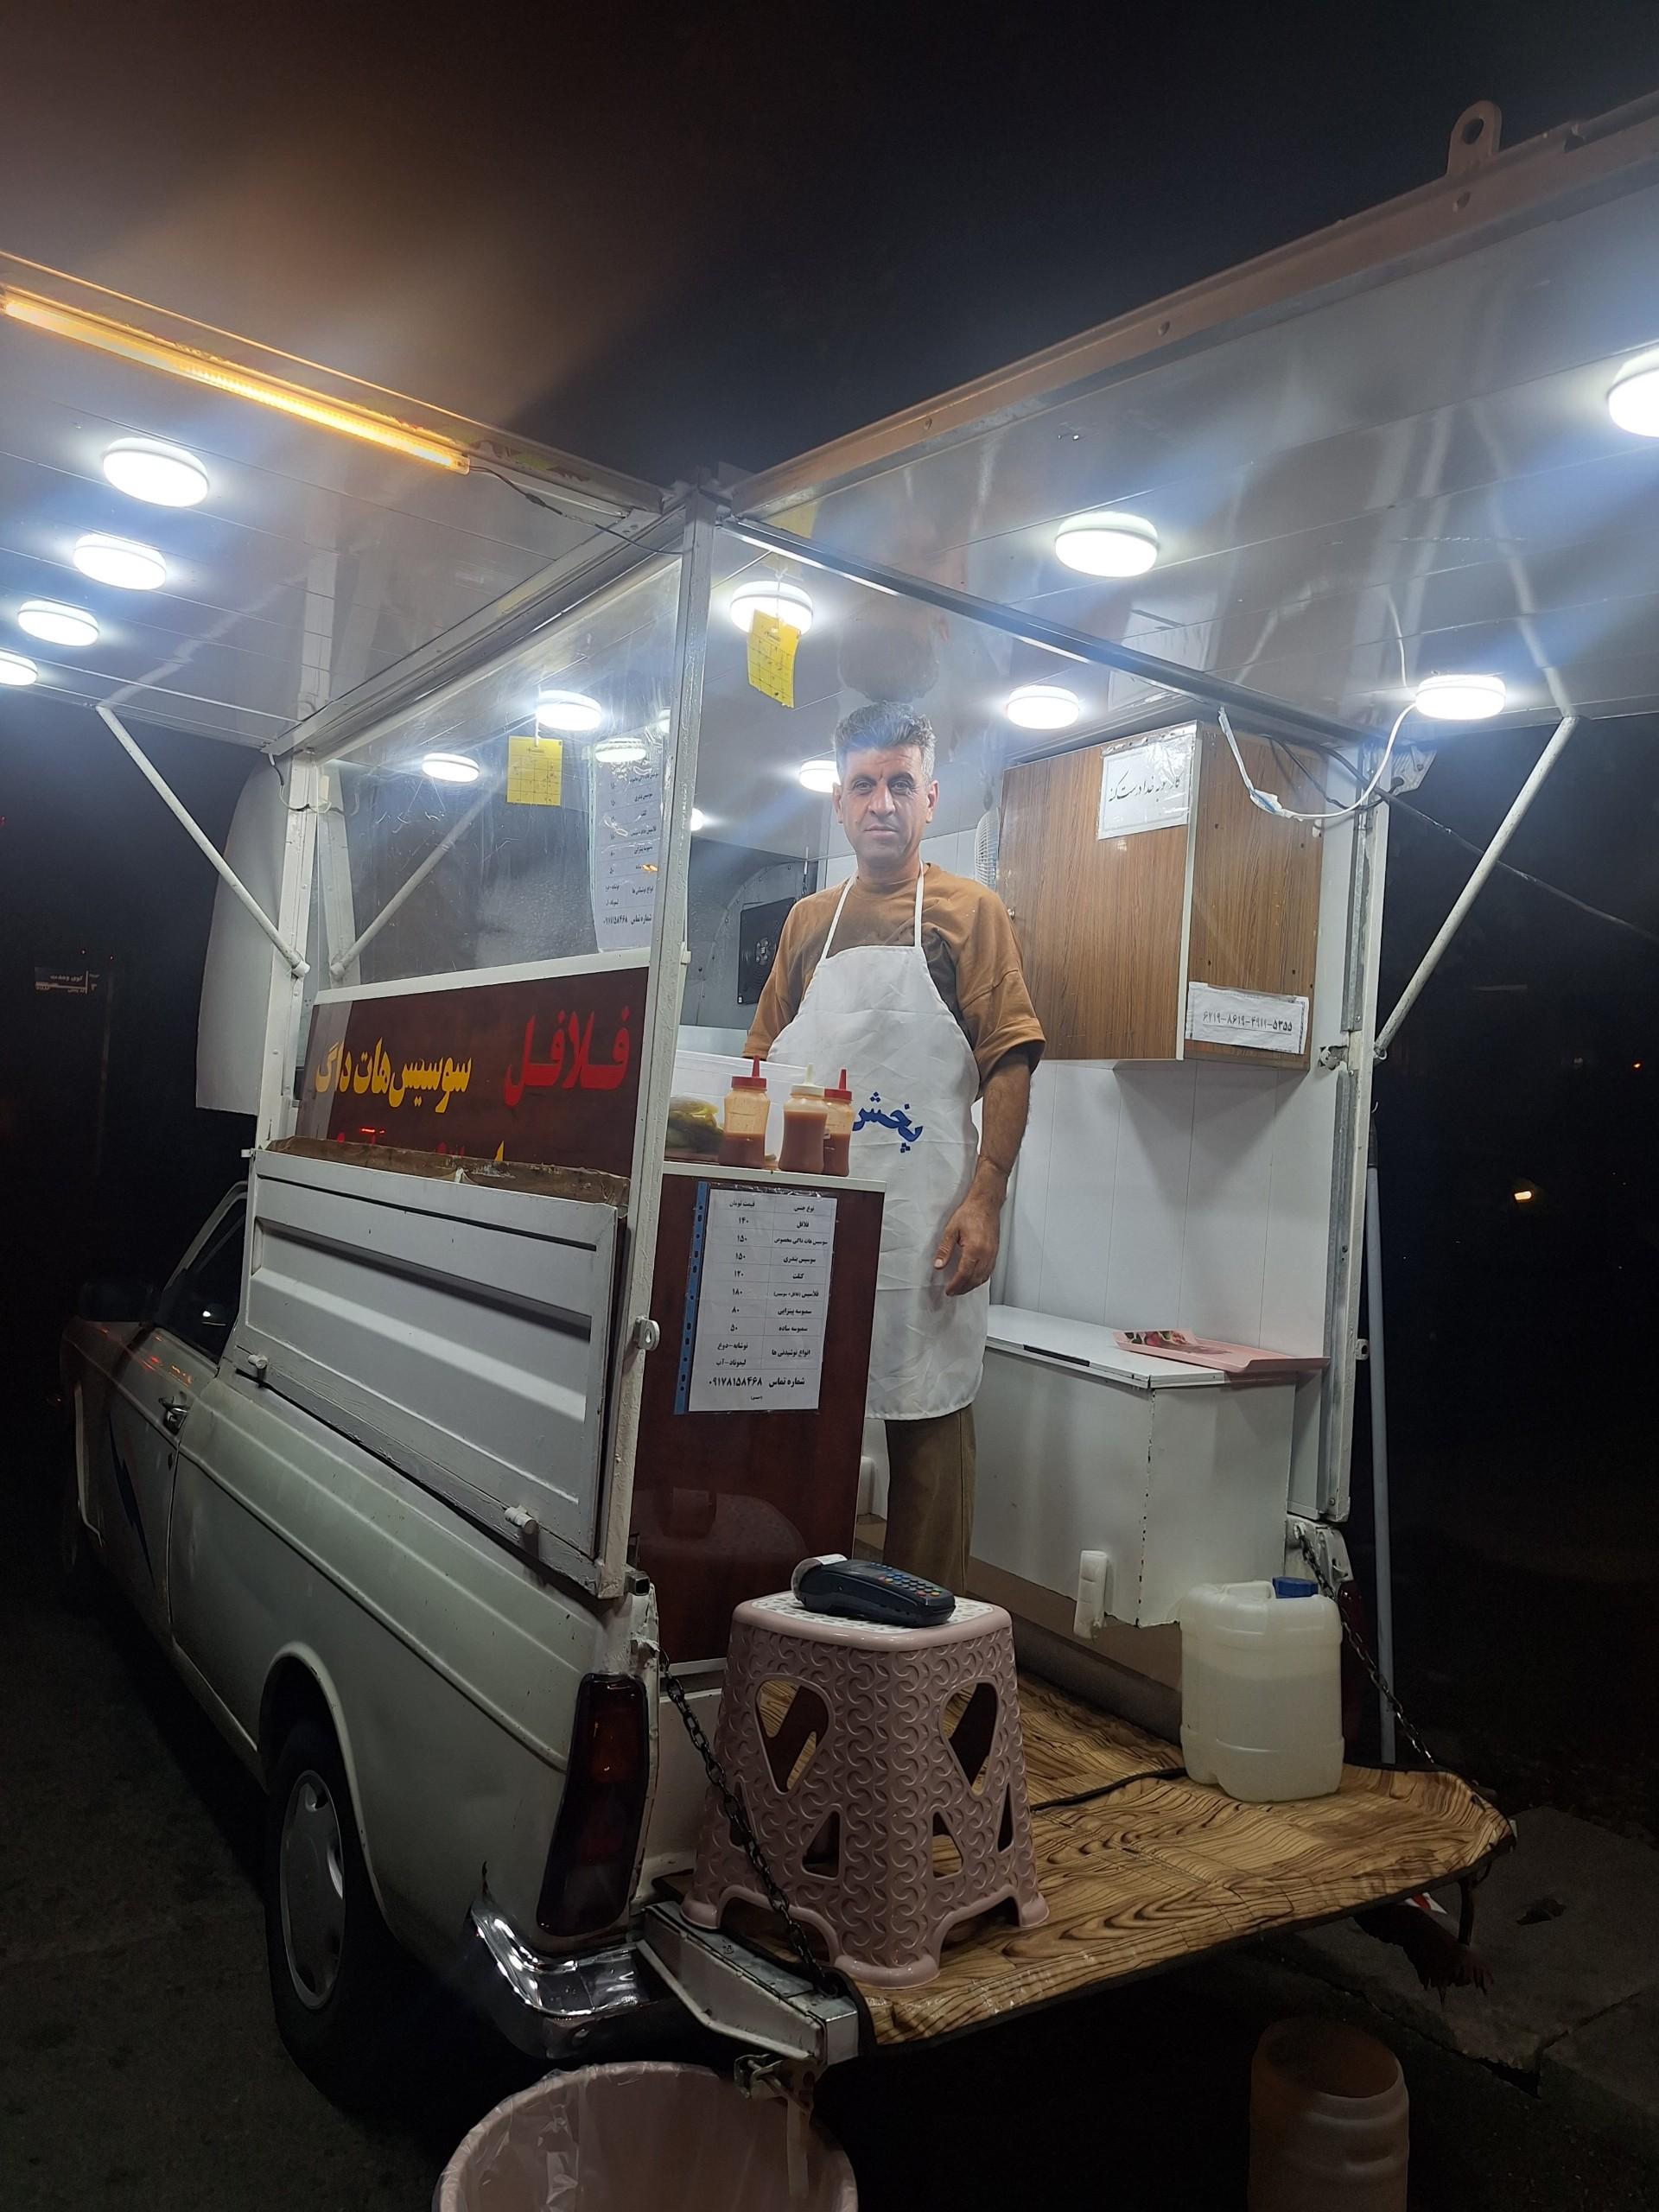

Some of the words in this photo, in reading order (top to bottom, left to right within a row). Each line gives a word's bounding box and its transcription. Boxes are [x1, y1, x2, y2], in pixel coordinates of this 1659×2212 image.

[504, 1005, 630, 1107] فلافل
[315, 1039, 353, 1094] داگ
[353, 1036, 392, 1095] هات
[389, 1056, 473, 1114] سوسیس
[729, 1199, 742, 1208] تومان
[806, 1205, 815, 1213] نوع
[797, 1219, 809, 1229] فلافل
[733, 1287, 743, 1296] ۱۸۰
[778, 1349, 798, 1357] نوشیدنی
[798, 1349, 810, 1357] انواع
[709, 1376, 762, 1386] ۰۹۱۷۸۱۵۸۴۶۸
[769, 1377, 786, 1388] تماس
[786, 1377, 805, 1388] شماره
